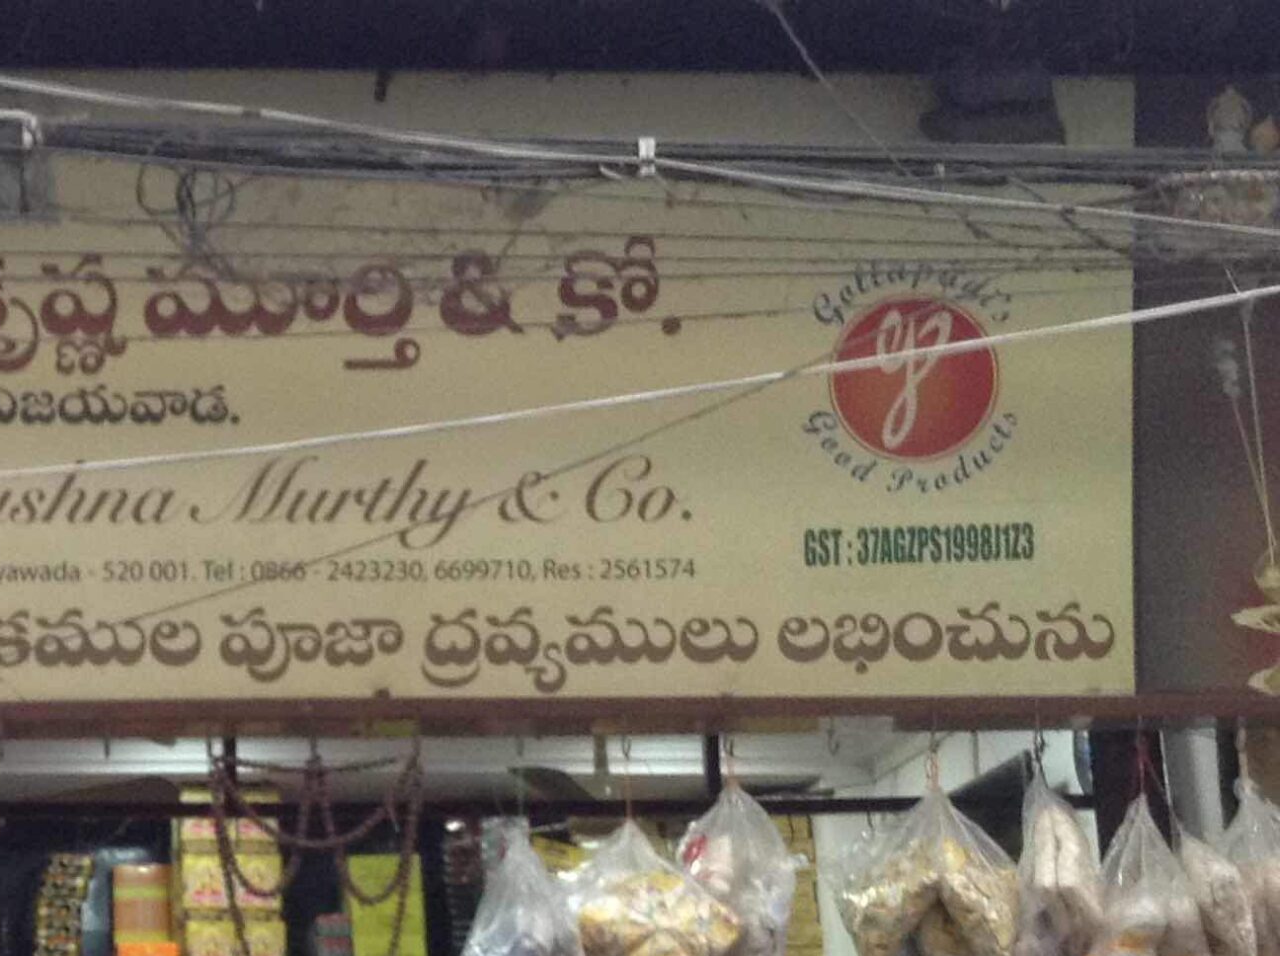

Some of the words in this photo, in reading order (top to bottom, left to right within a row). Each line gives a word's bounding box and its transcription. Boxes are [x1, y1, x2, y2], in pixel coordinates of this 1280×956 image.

[439, 249, 524, 335] &
[886, 412, 1019, 494] Products
[189, 453, 474, 549] Murthy
[497, 470, 562, 524] &
[583, 453, 694, 524] Co.
[102, 561, 144, 581] 520
[251, 560, 307, 581] 0866
[599, 558, 697, 580] 2561574
[218, 606, 405, 682] పూజా
[421, 605, 759, 693] ద్రవ్యములు
[777, 601, 1116, 675] లభించును
